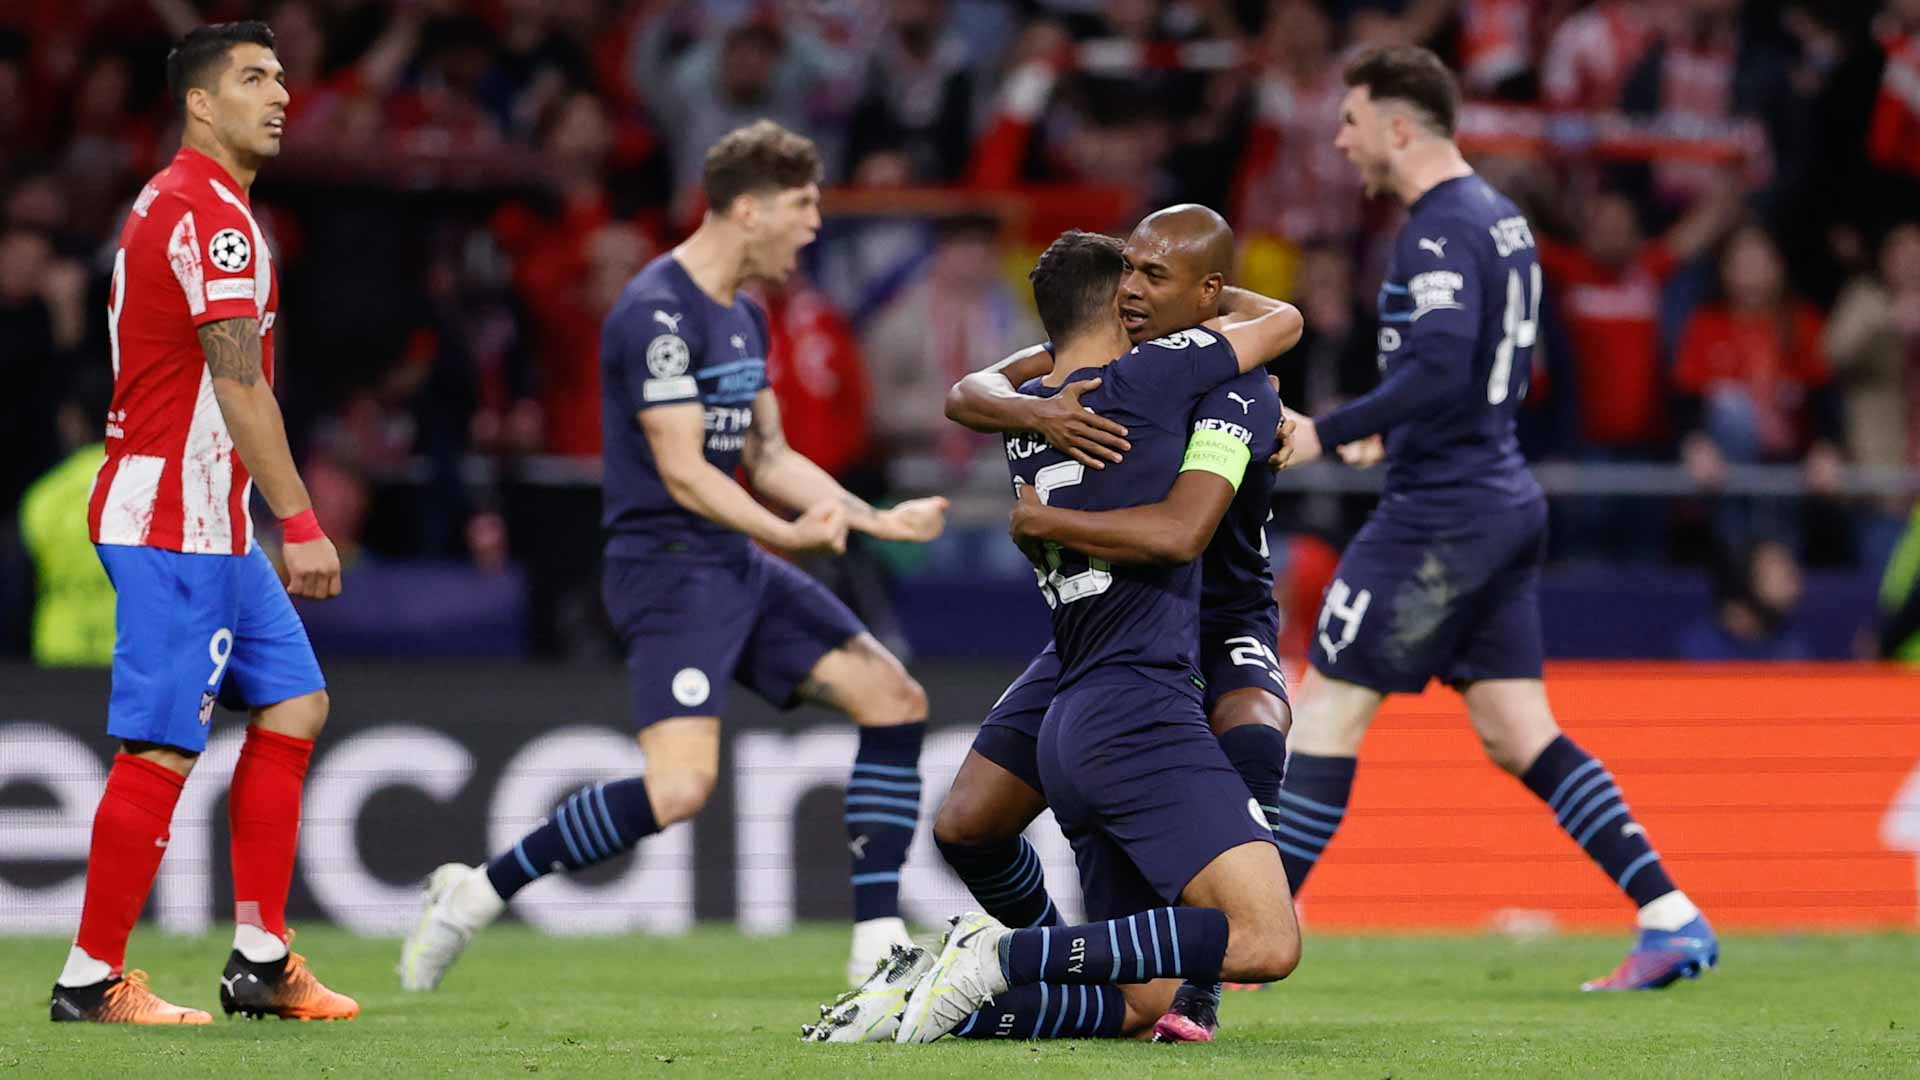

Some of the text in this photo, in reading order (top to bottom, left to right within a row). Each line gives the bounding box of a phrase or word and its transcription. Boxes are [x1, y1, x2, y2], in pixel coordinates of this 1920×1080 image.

[1194, 418, 1253, 445] NEXEN
[208, 627, 234, 686] 9
[1067, 937, 1086, 974] CITY
